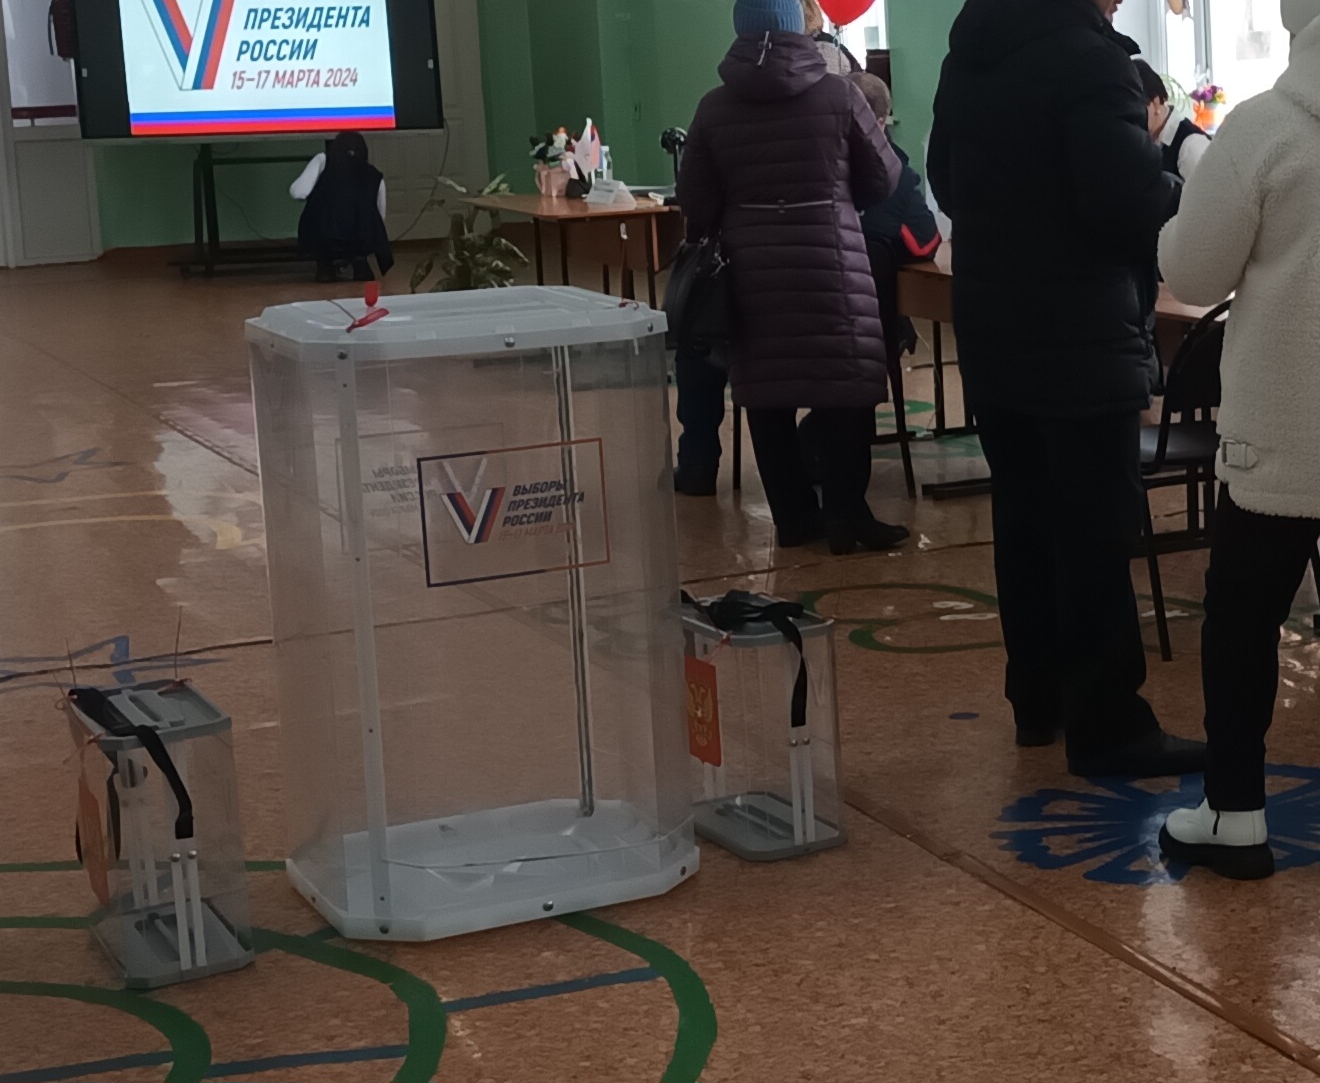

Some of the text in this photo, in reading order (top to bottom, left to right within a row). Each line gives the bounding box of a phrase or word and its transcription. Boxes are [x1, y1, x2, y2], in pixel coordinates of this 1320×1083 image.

[243, 5, 371, 33] ПРЕЗИДЕНТА
[236, 38, 318, 62] РОССИИ
[272, 68, 321, 89] МАРТА
[323, 67, 358, 88] 2024
[512, 479, 567, 496] ВЫБОРЫ
[507, 492, 584, 512] ПРЕЗИДЕНТА
[502, 511, 552, 527] РОССИИ
